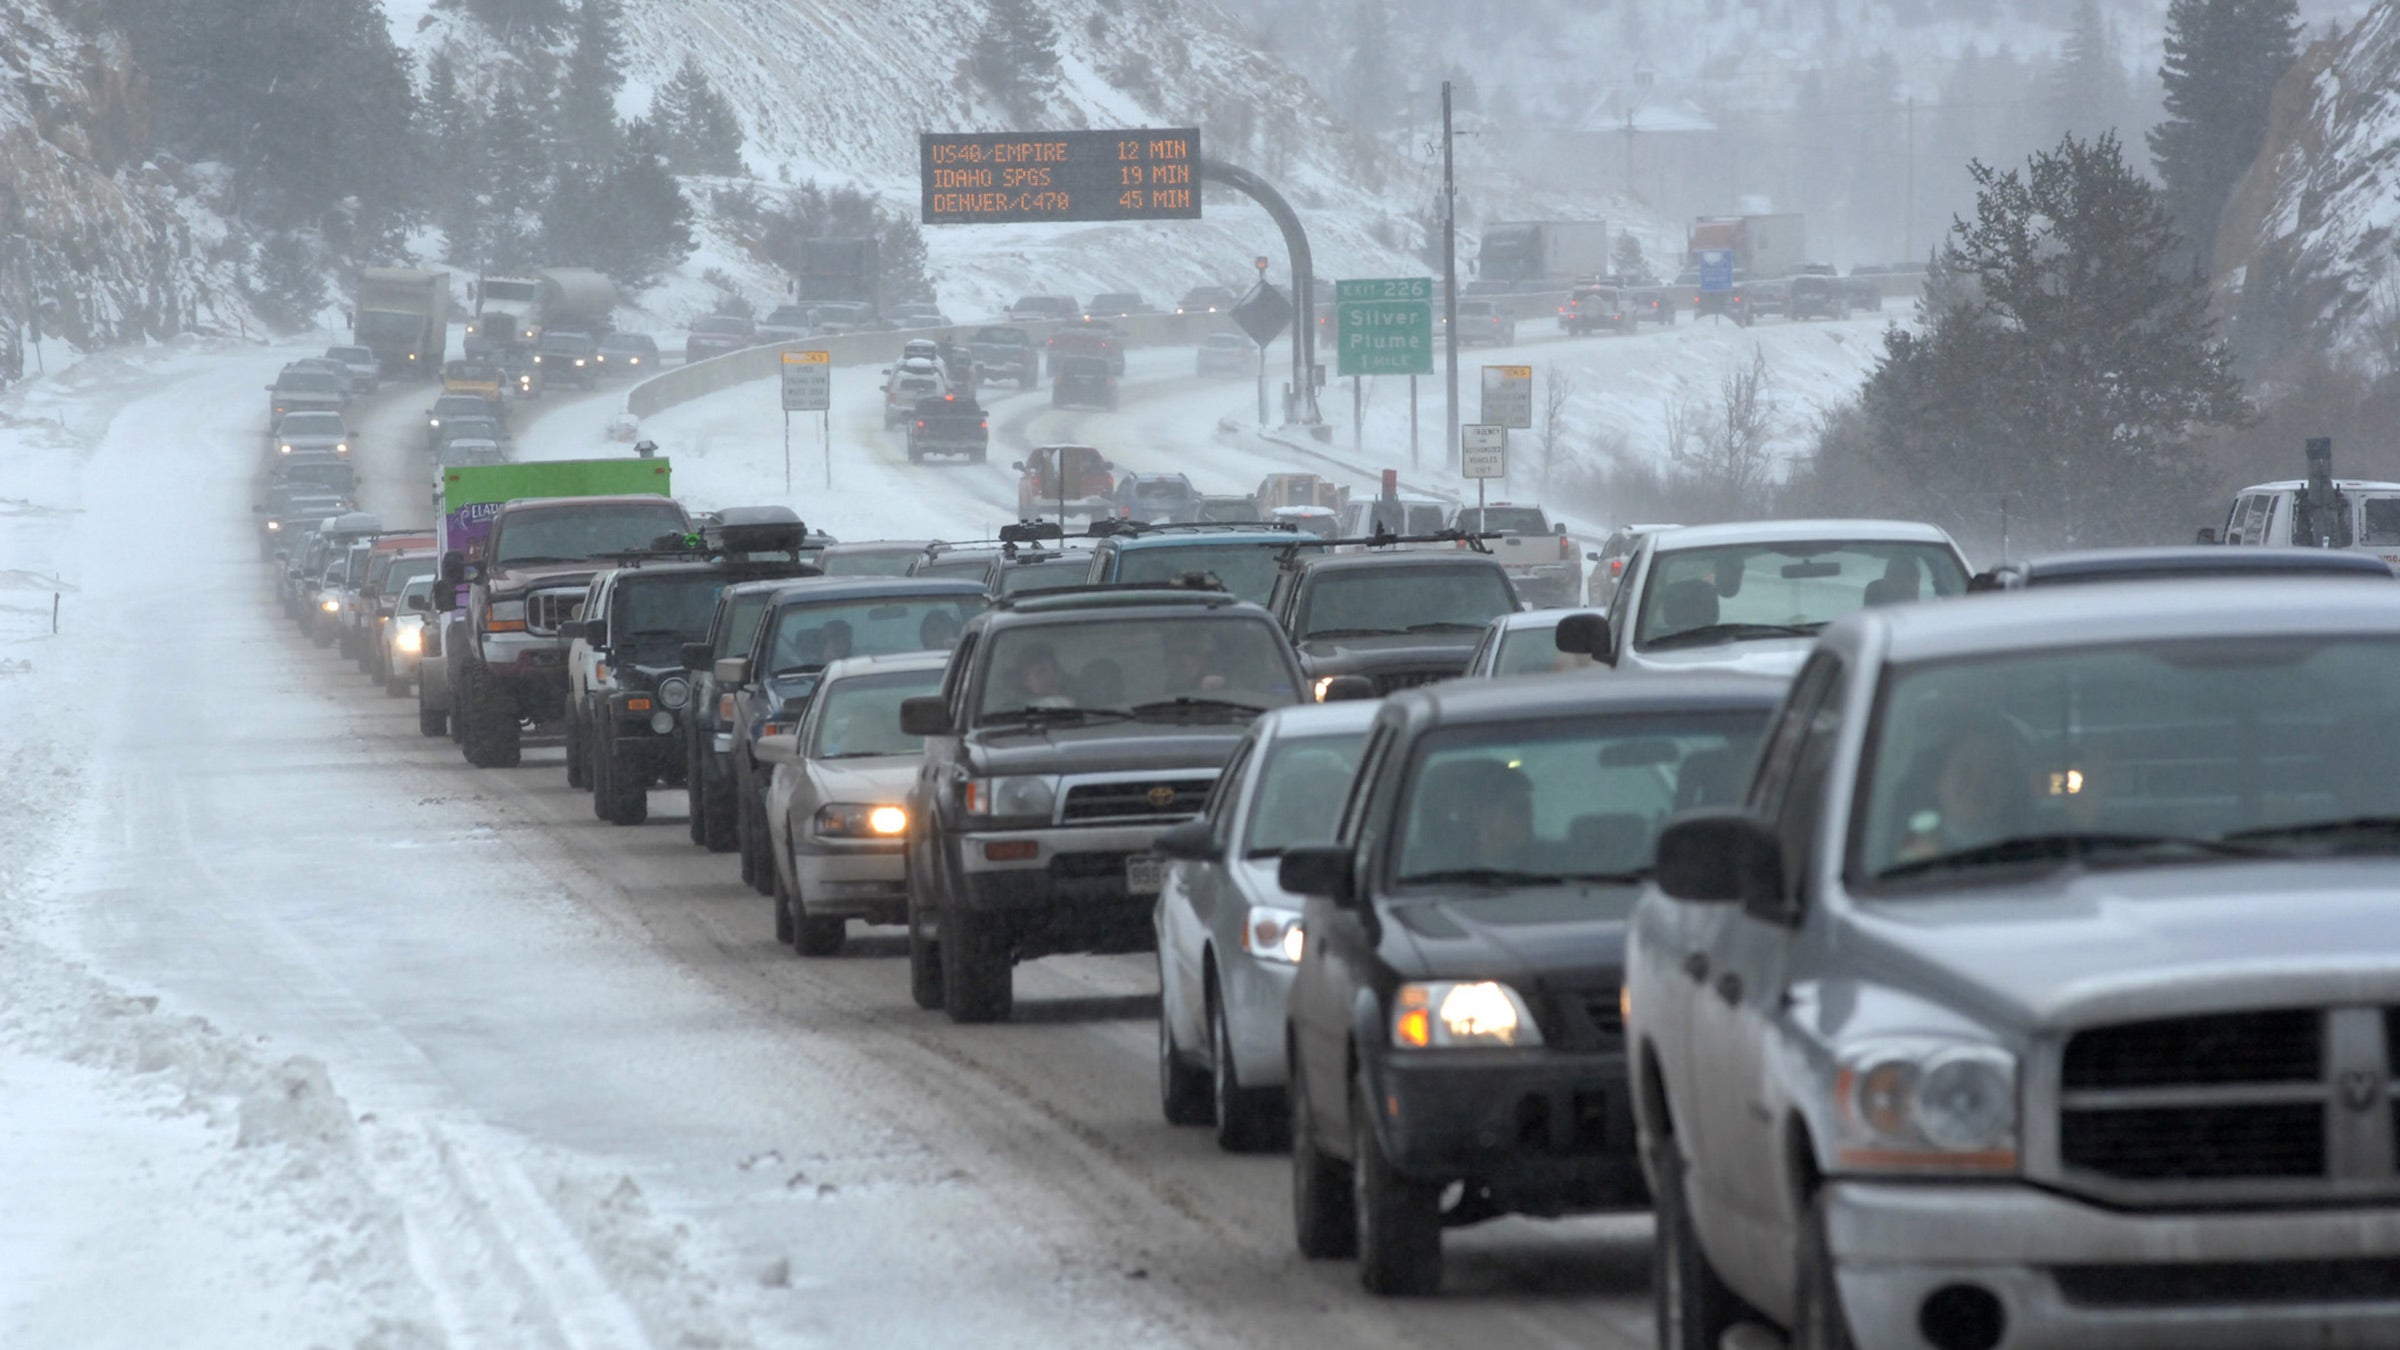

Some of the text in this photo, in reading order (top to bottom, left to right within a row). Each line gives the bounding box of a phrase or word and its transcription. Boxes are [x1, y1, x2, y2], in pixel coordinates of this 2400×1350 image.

[932, 139, 1187, 163] US40/EMPIRE 12 MIN
[934, 164, 1190, 188] IDAHO SPGS 19 MIN
[934, 189, 1190, 212] DENVER/C470 45 MIN
[1343, 280, 1424, 297] EXIT 226
[1350, 309, 1419, 326] Silver
[1350, 333, 1419, 349] Plume
